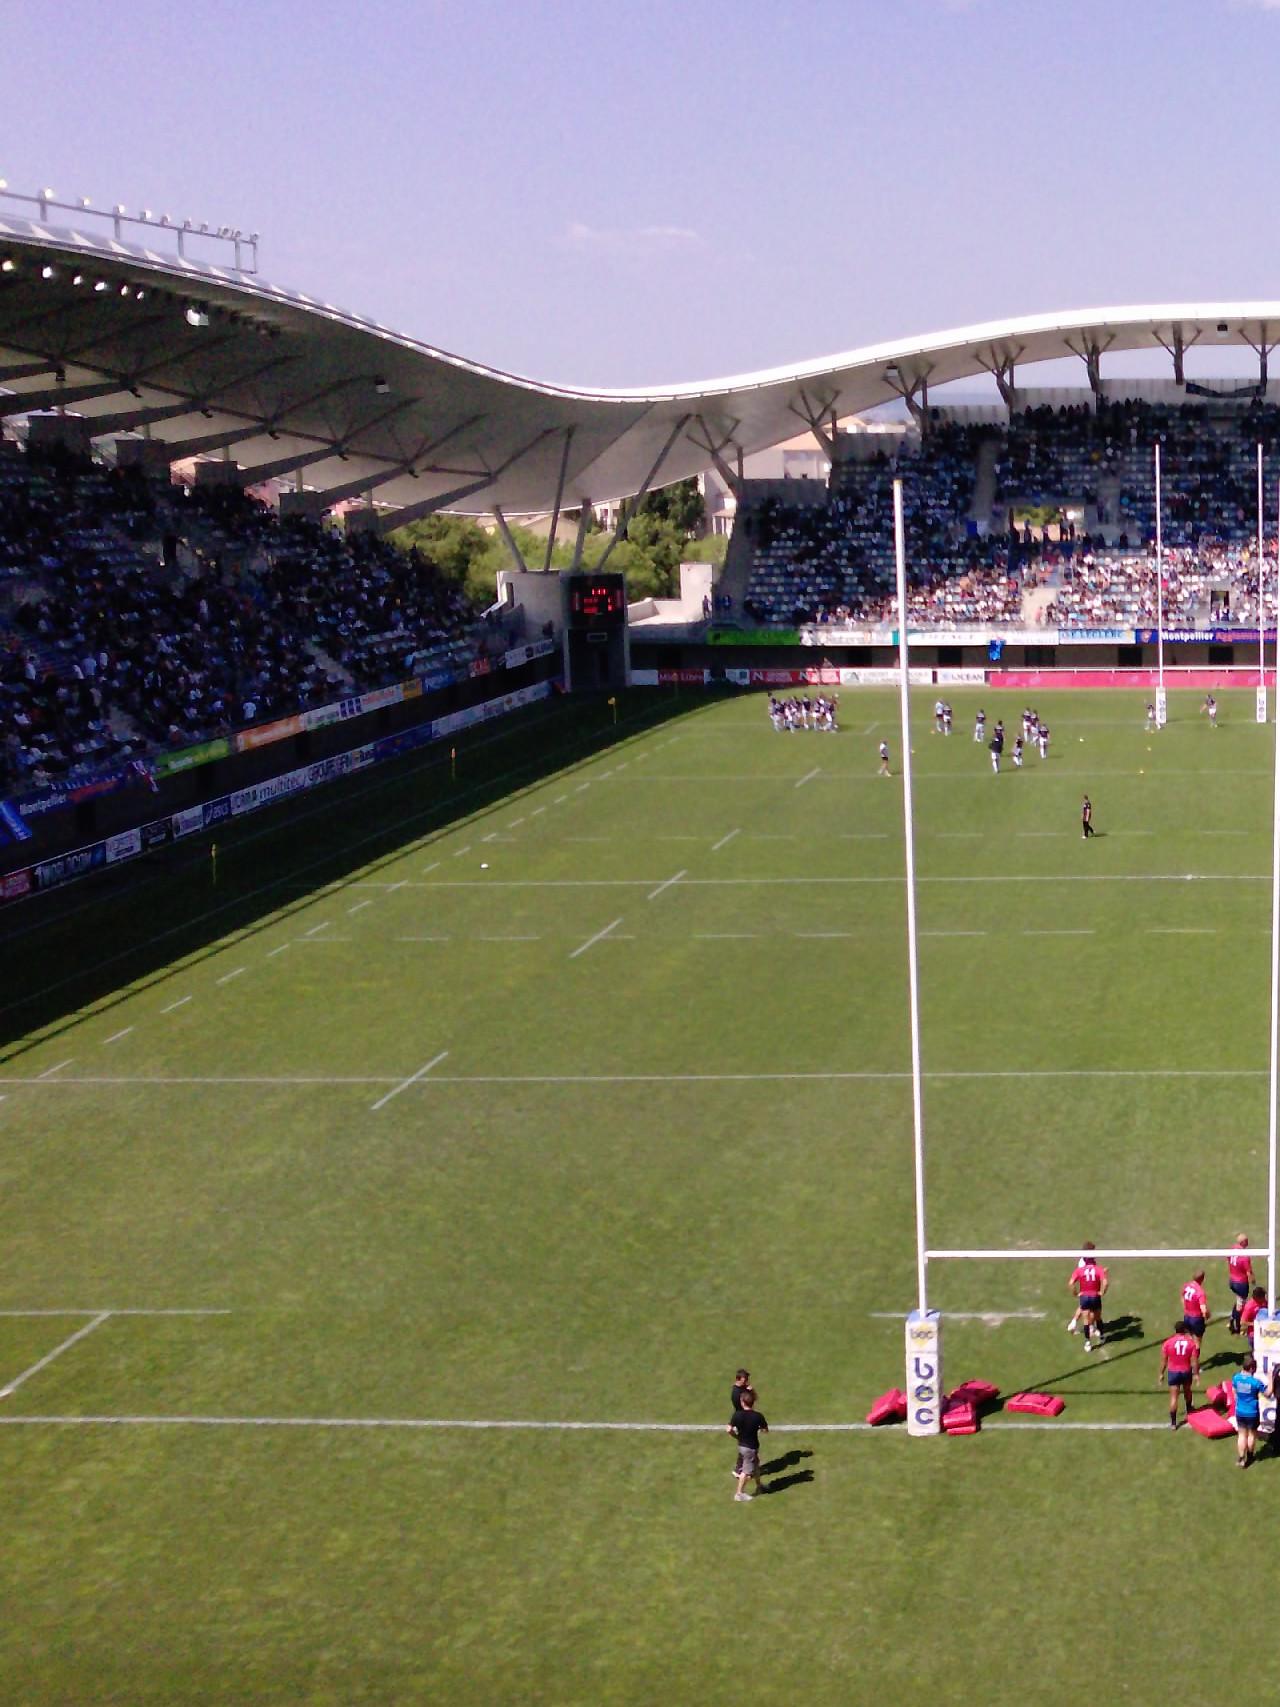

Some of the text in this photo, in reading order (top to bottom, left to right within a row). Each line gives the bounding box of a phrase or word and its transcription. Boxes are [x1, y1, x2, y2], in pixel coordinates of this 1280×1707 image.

[1161, 630, 1214, 643] Montpellier
[1083, 1267, 1096, 1282] 11
[1174, 1340, 1188, 1355] 17
[914, 1357, 935, 1425] bec
